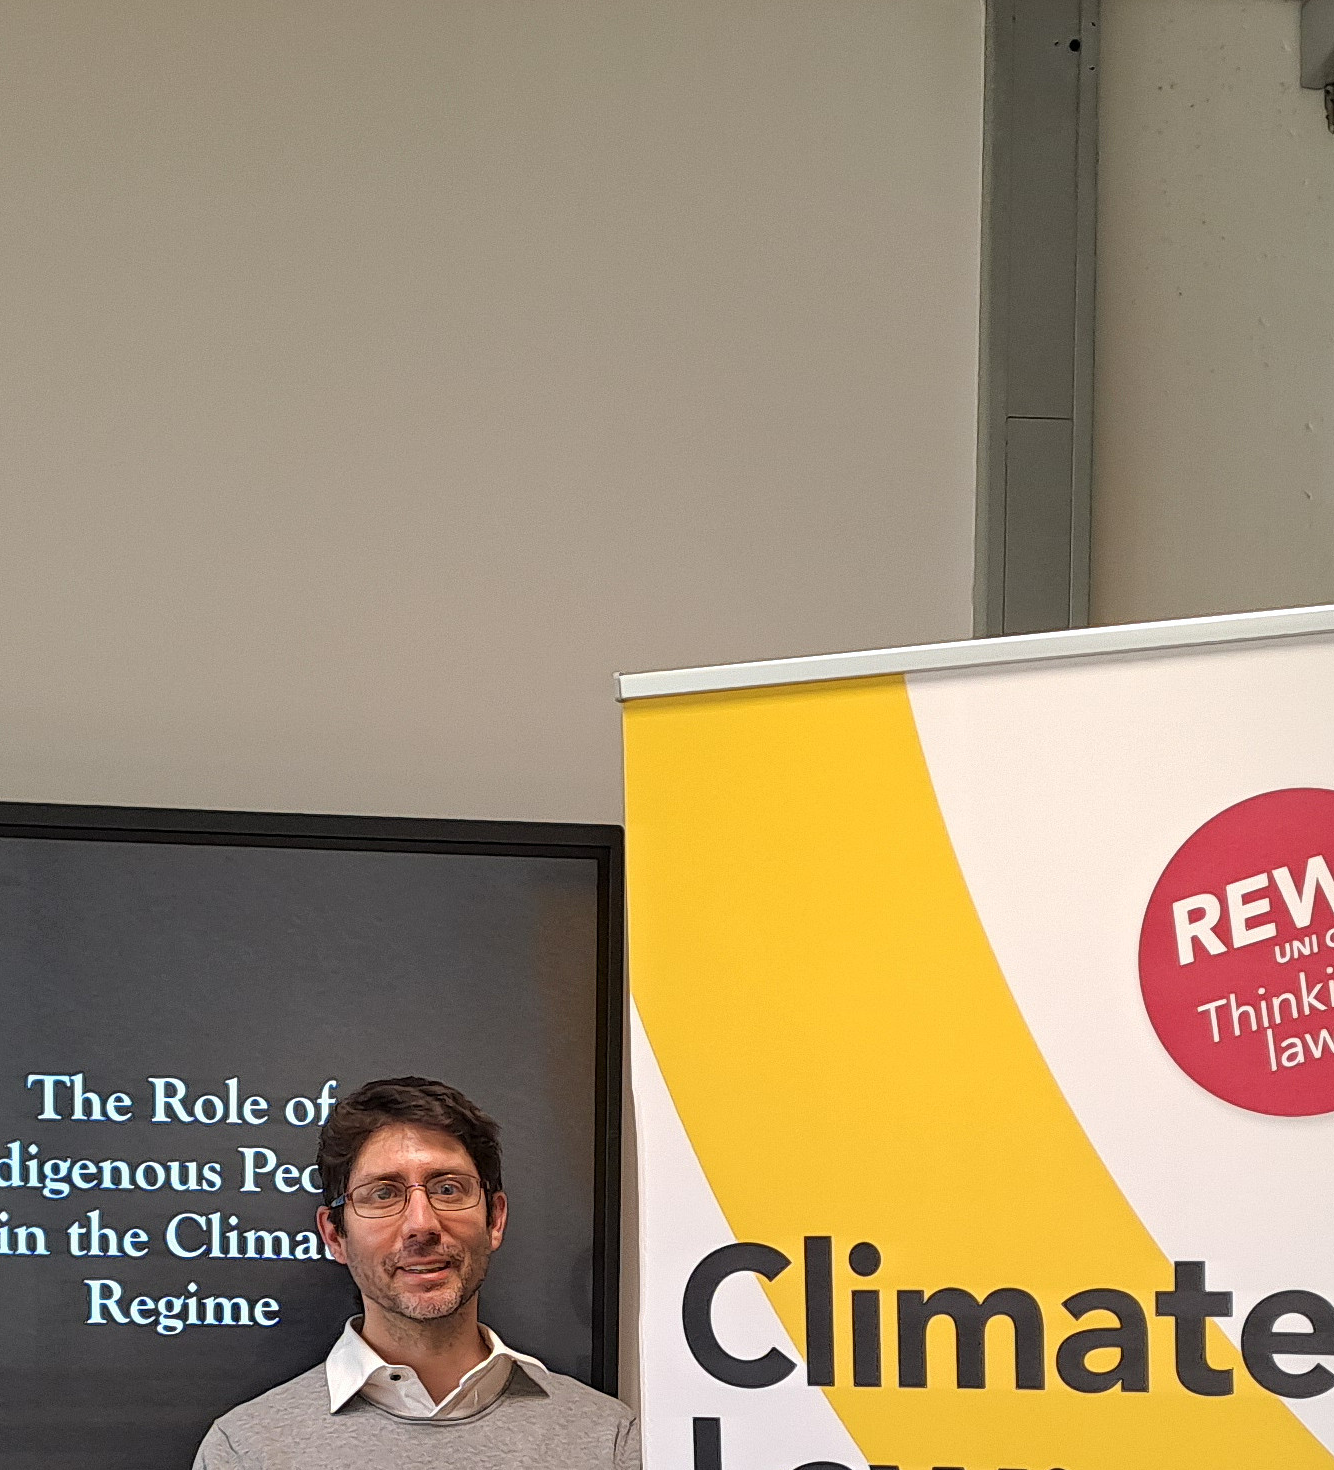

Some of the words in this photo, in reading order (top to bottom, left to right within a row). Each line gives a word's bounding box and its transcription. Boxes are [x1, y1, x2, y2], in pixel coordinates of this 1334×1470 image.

[1274, 934, 1319, 964] UNI
[27, 1073, 133, 1122] The
[147, 1077, 269, 1125] Role
[285, 1079, 337, 1126] of
[66, 1209, 149, 1258] the
[83, 1279, 280, 1335] Regime
